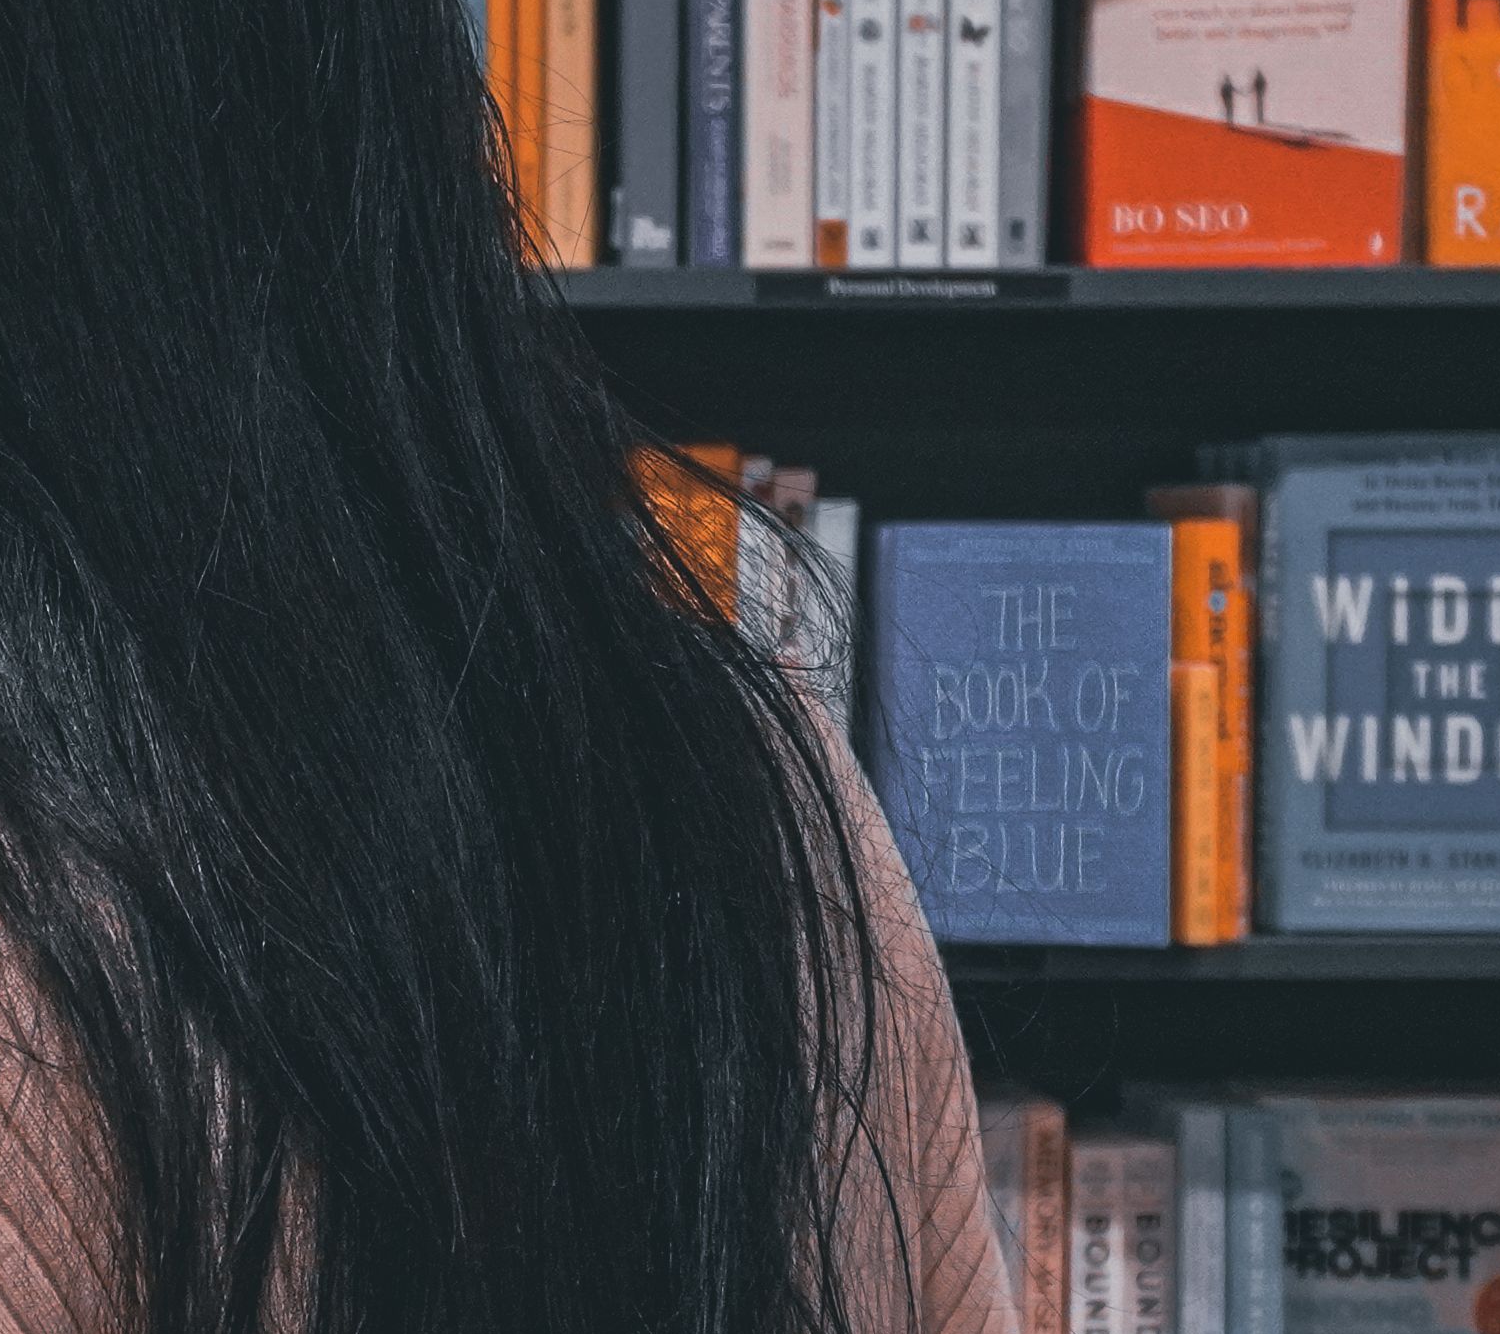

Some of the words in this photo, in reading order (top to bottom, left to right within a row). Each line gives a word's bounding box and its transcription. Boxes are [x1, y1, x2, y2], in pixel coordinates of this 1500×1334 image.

[1112, 205, 1164, 235] BO
[1175, 204, 1251, 235] SEO
[828, 279, 896, 297] Personal
[899, 280, 996, 297] Development
[979, 585, 1077, 652] THE
[933, 668, 1058, 738] BOOK
[1075, 671, 1132, 732] OF
[1411, 660, 1488, 700] THE
[921, 749, 1146, 821] FEELING
[948, 827, 1105, 895] BLUE
